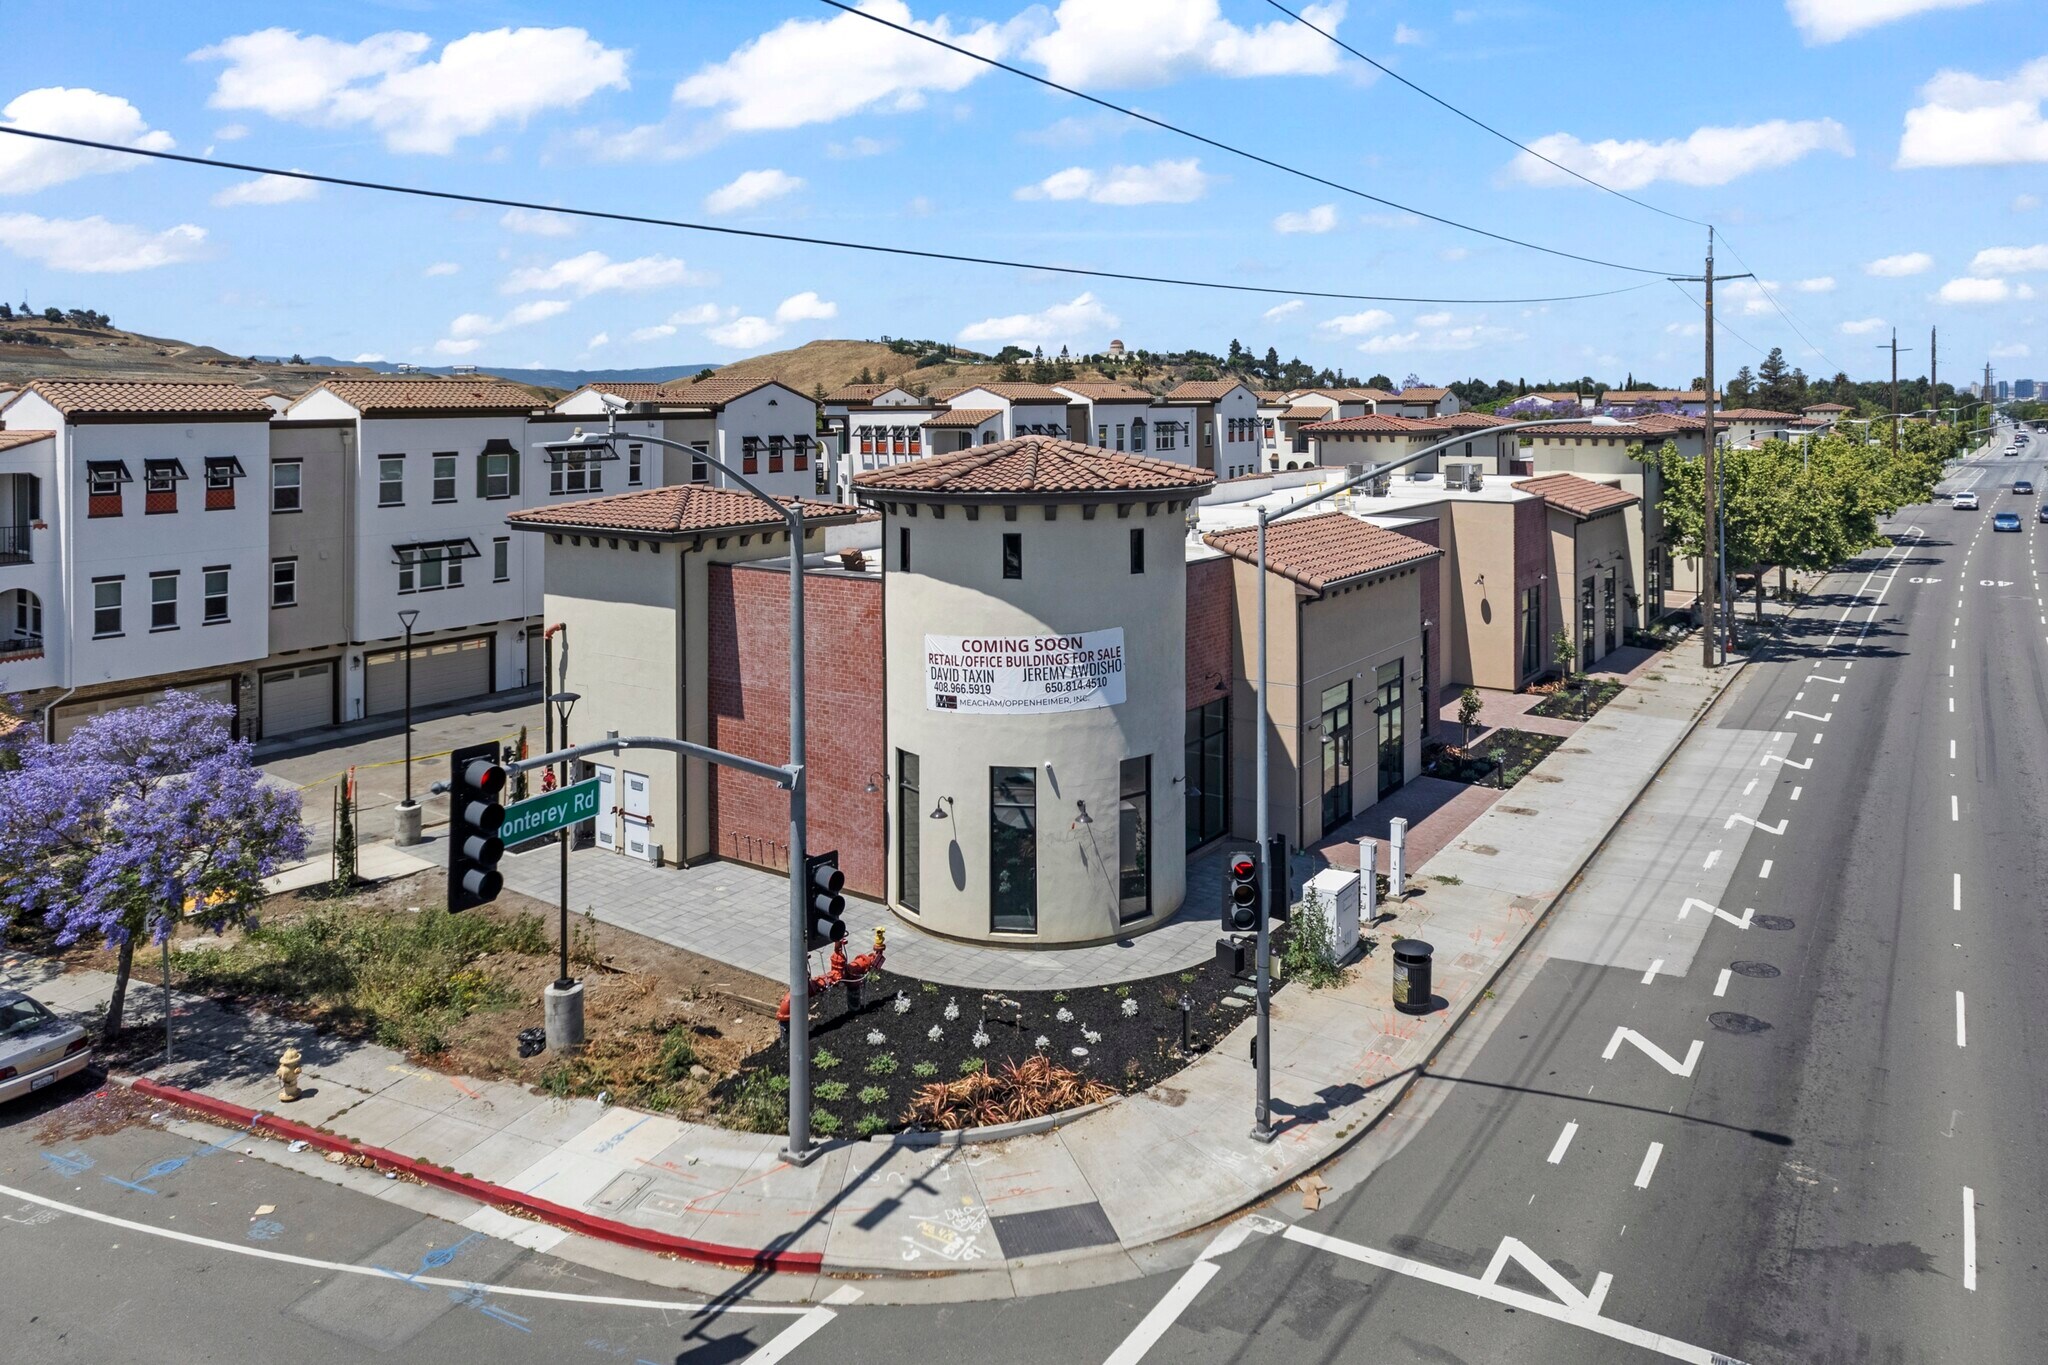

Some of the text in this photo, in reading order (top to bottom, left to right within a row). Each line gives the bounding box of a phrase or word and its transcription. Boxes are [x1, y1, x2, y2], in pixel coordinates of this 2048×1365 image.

[961, 636, 1083, 653] COMING SOON
[928, 646, 1121, 668] RETAIL/OFFICE BUILDINGS FOR SALE
[930, 667, 995, 683] DAVID TAXIN
[1022, 659, 1122, 682] JEREMY AWDISHO
[934, 683, 991, 695] 408.966.5919
[1045, 676, 1108, 693] 650.814.4510
[959, 698, 1072, 708] MEACHAM/OPPENHEIMER,
[497, 789, 594, 839] onterey Rd
